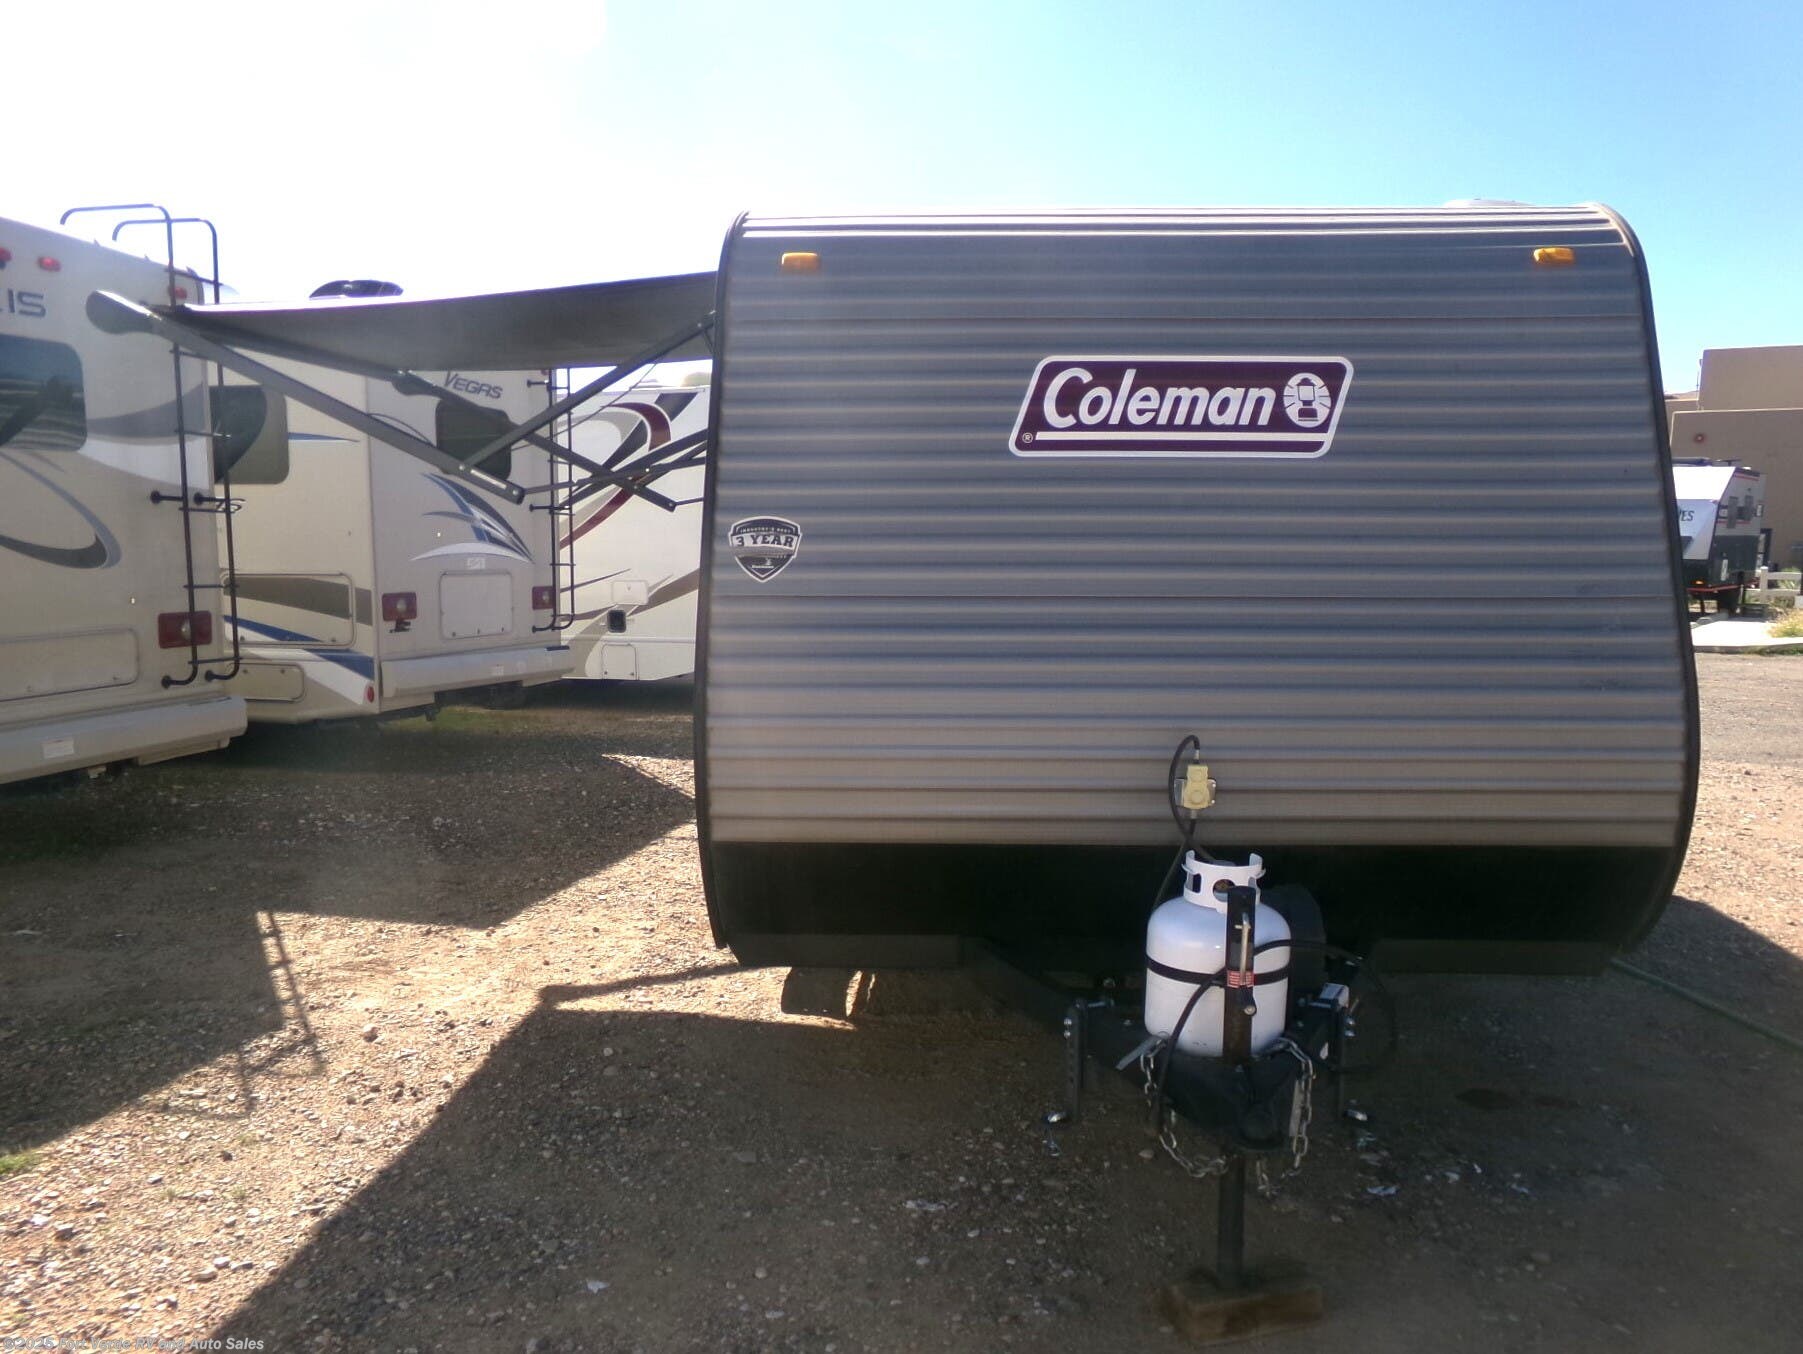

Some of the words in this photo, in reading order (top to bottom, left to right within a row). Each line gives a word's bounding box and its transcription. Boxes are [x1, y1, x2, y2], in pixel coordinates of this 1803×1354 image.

[0, 288, 46, 318] IS
[444, 370, 503, 399] VEGAS
[1043, 367, 1277, 428] Coleman
[735, 535, 745, 547] 3
[750, 534, 794, 548] YEAR
